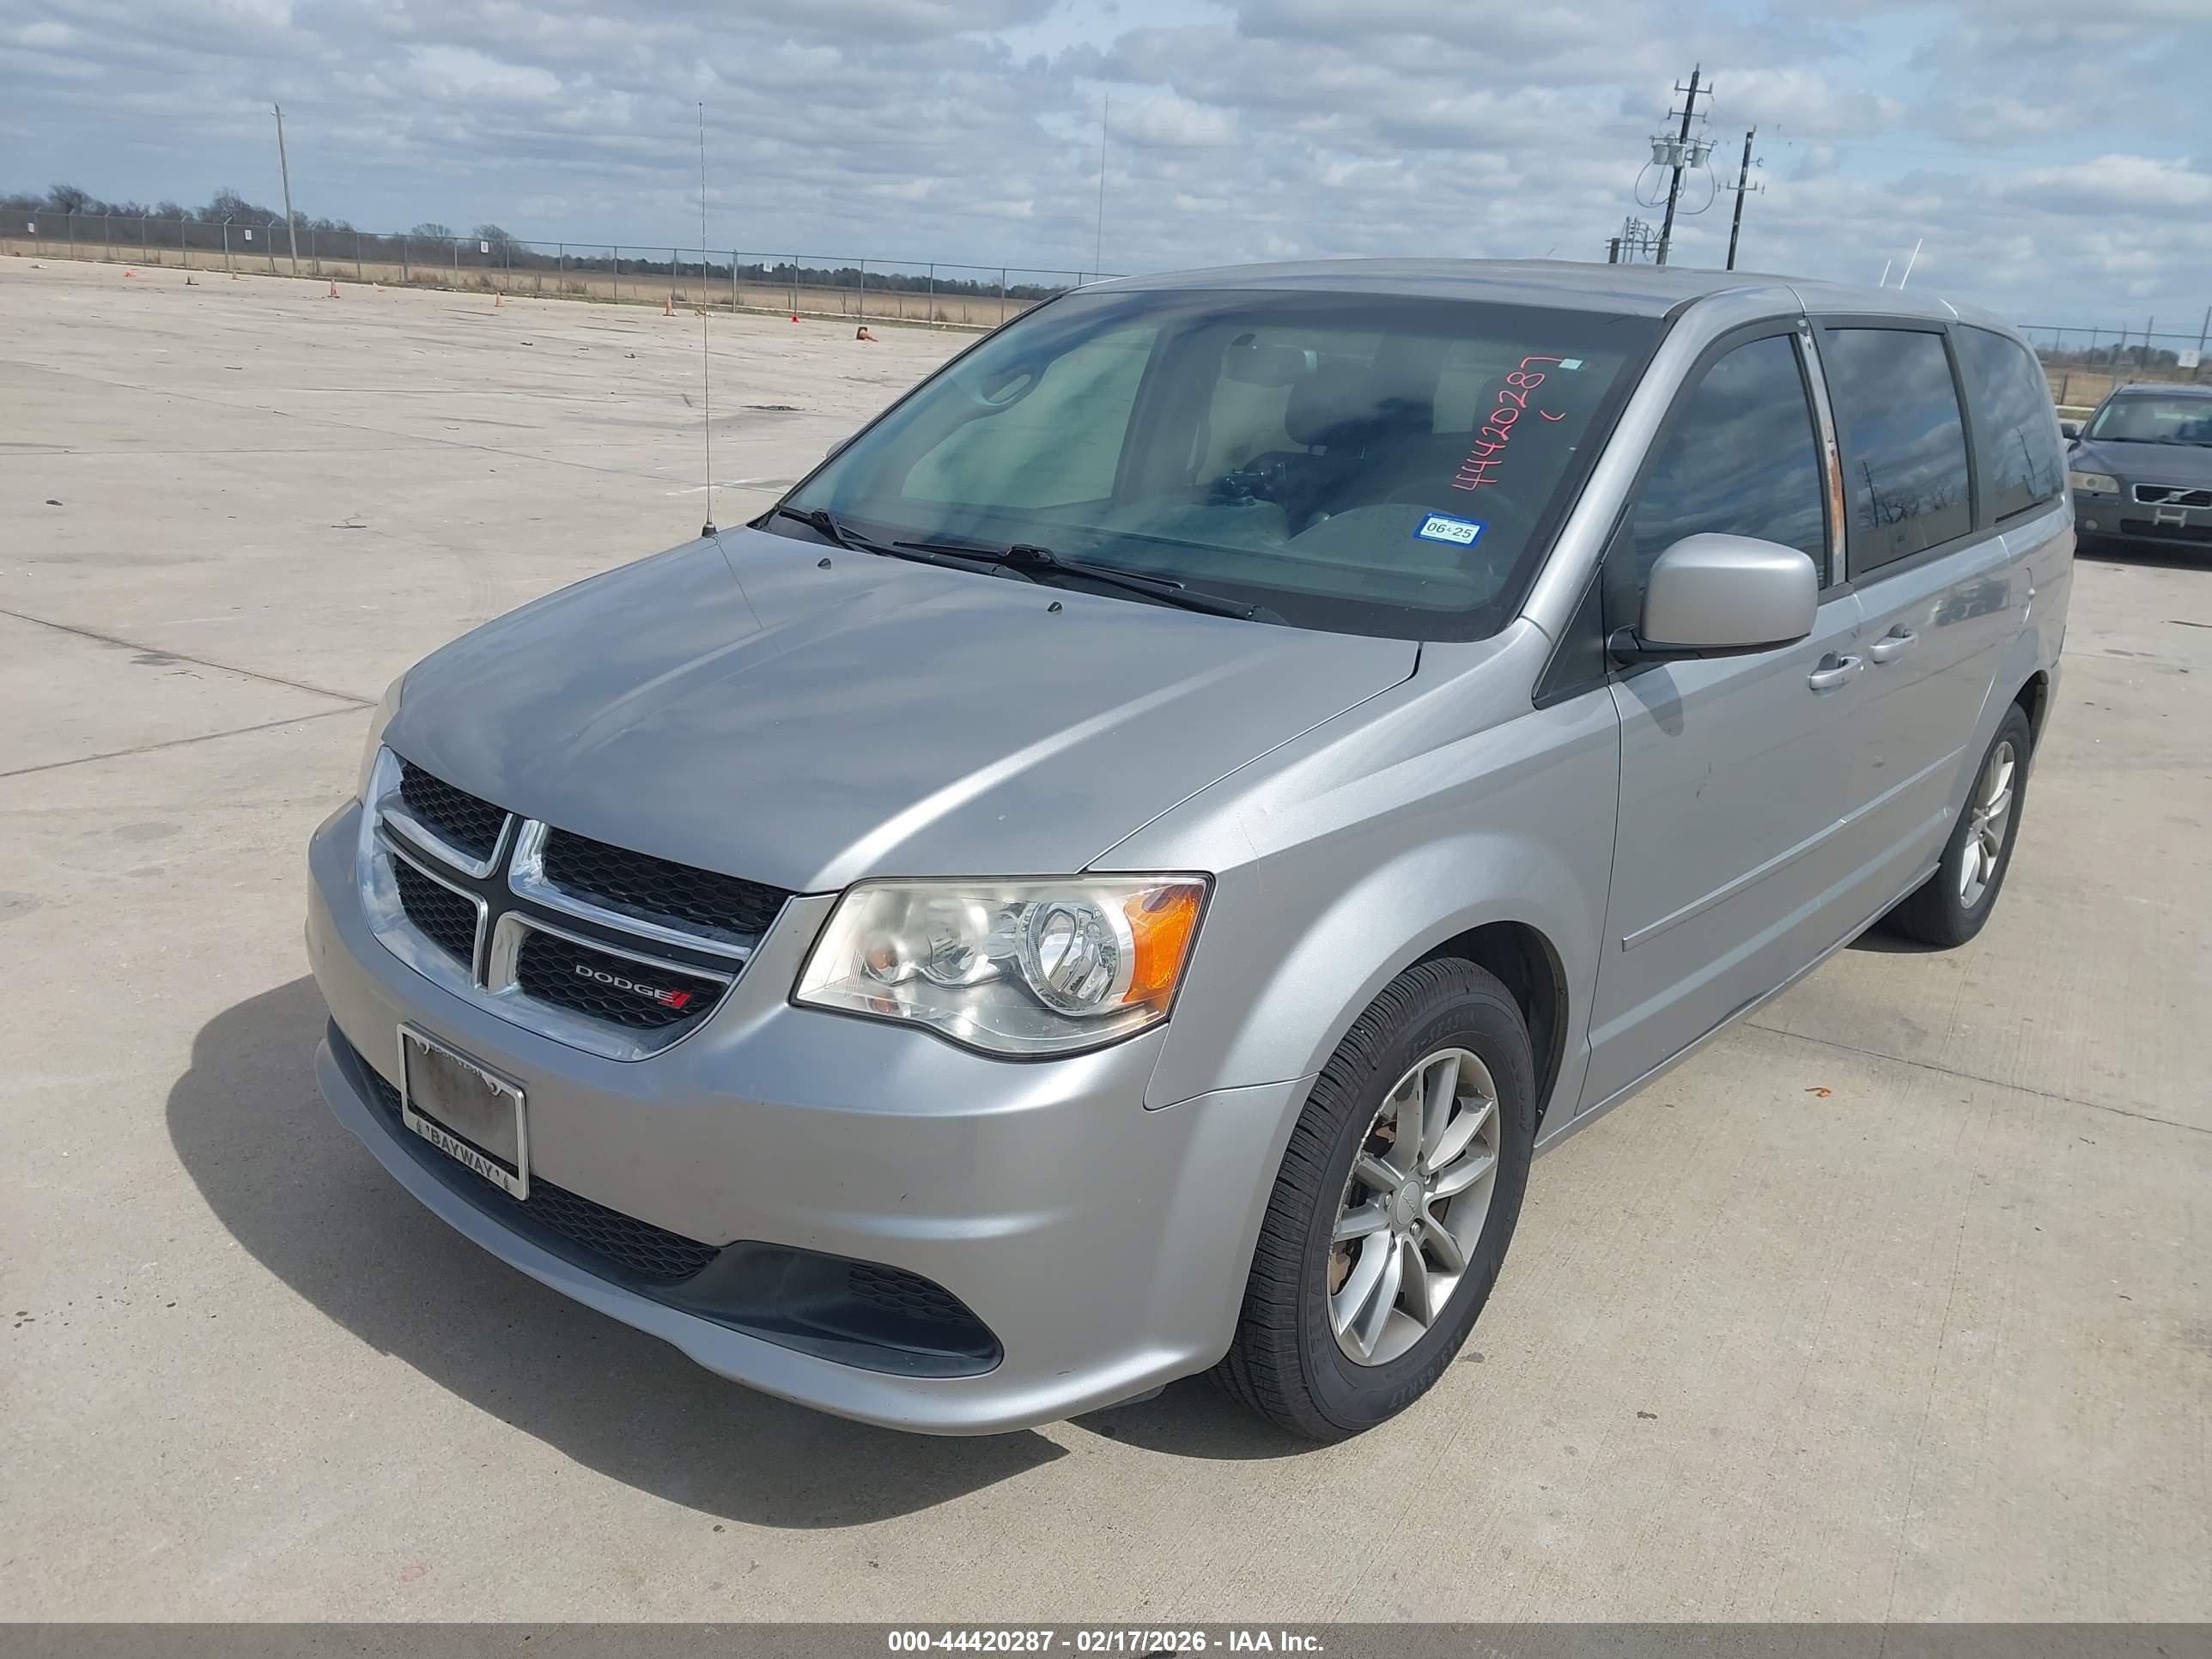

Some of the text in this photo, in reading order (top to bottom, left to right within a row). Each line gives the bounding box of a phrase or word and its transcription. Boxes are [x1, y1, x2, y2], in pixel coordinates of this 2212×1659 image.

[1450, 356, 1563, 490] 44420287
[1426, 522, 1474, 538] 06 25
[575, 963, 675, 1003] DODGE
